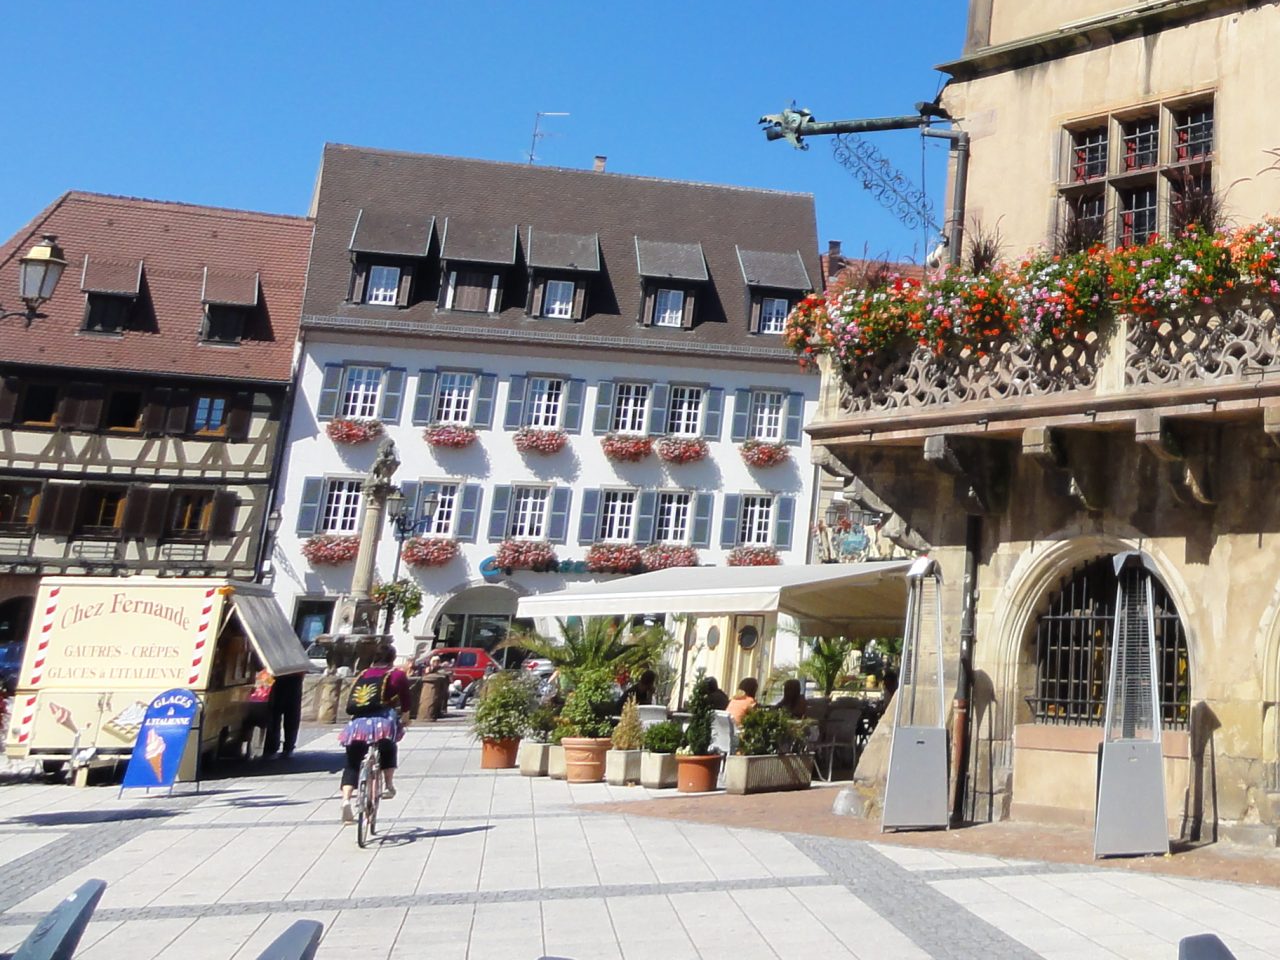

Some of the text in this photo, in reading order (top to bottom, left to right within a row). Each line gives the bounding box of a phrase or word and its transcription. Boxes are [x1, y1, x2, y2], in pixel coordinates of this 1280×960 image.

[61, 592, 191, 631] Chez Fernande
[63, 645, 122, 658] GAUFRES
[131, 642, 180, 658] CRÊPES
[47, 667, 97, 679] GLACES
[153, 694, 194, 709] GLACES
